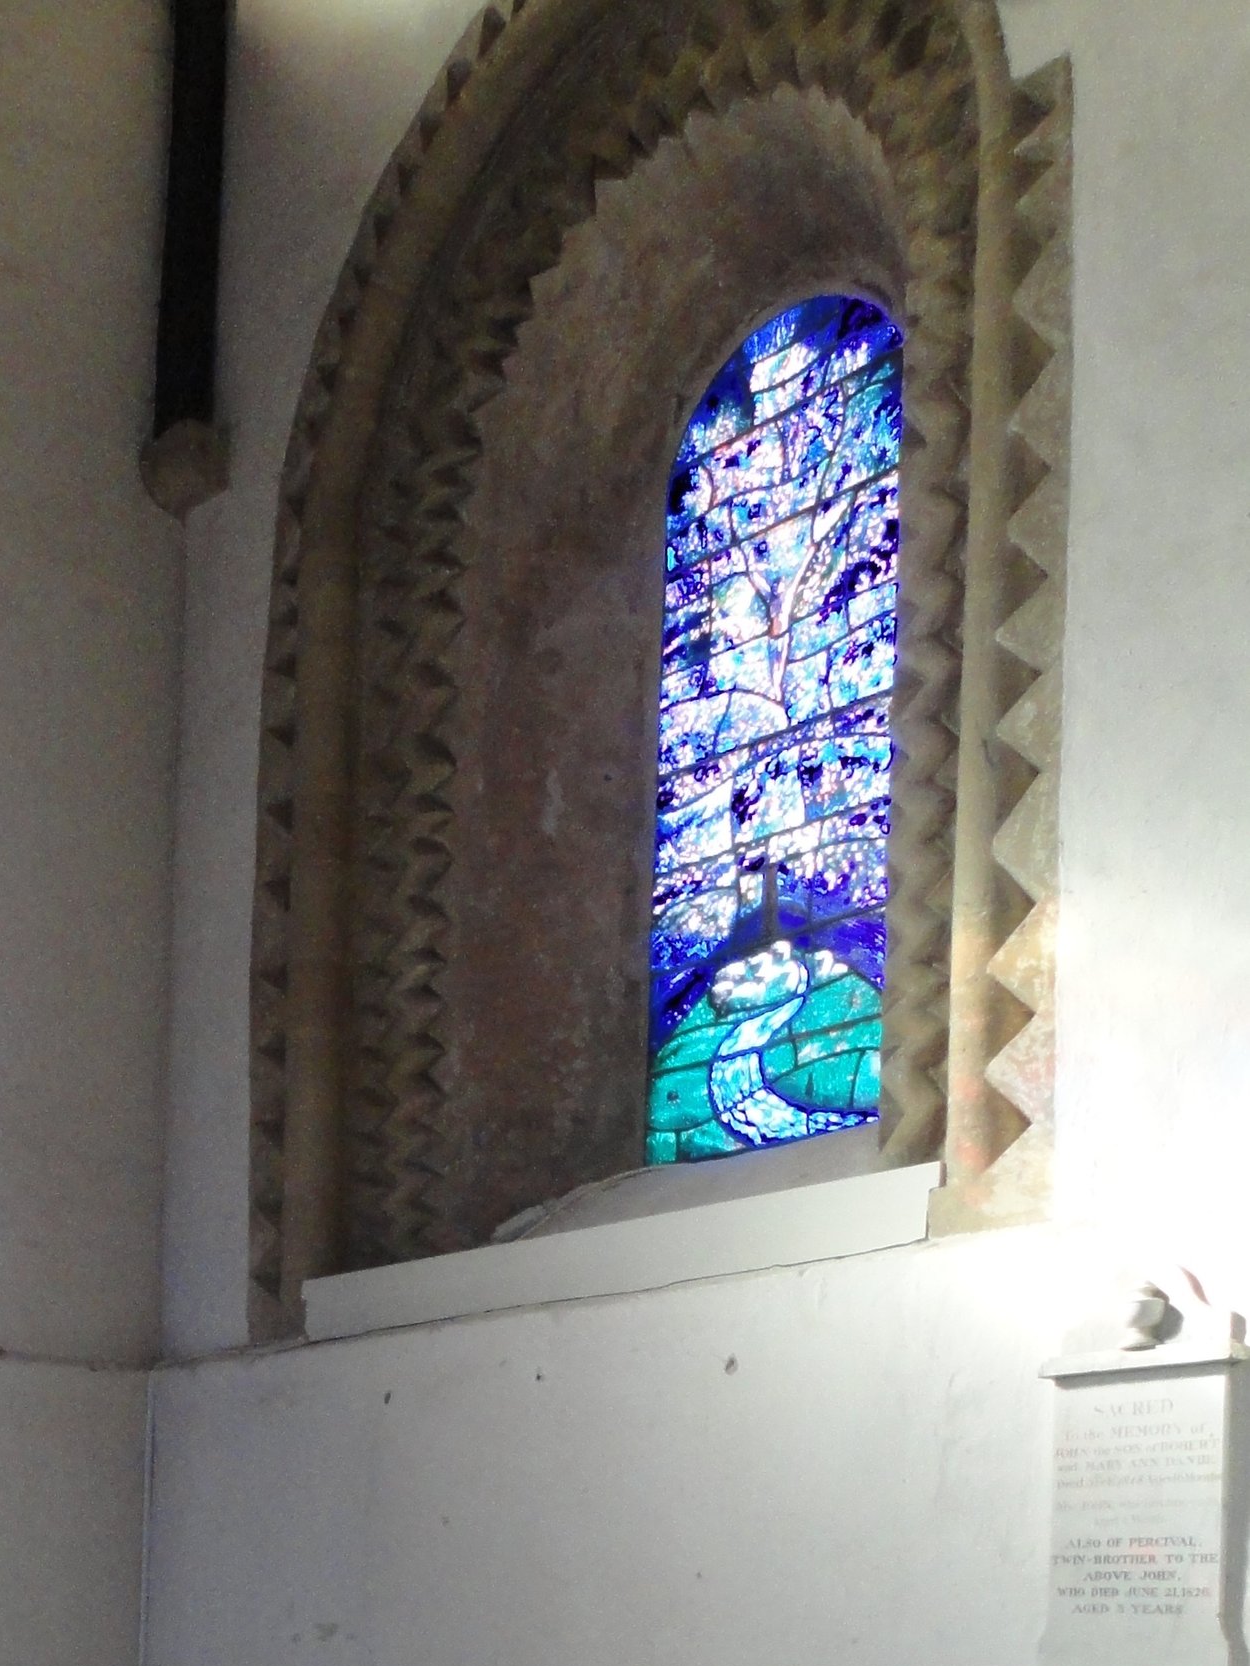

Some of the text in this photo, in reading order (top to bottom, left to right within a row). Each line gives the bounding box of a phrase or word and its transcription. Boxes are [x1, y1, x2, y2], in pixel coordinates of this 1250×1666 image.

[1093, 1398, 1174, 1417] SACRED
[1067, 1537, 1102, 1550] ALSO
[1106, 1537, 1123, 1548] OF
[1165, 1554, 1184, 1564] TO
[1189, 1553, 1219, 1564] THE
[1082, 1570, 1133, 1582] ABOVE
[1056, 1588, 1087, 1598] WHO
[1090, 1587, 1120, 1597] DIED
[1125, 1586, 1159, 1598] JUNE
[1071, 1604, 1110, 1615] AGED
[1130, 1603, 1184, 1616] YEARS
